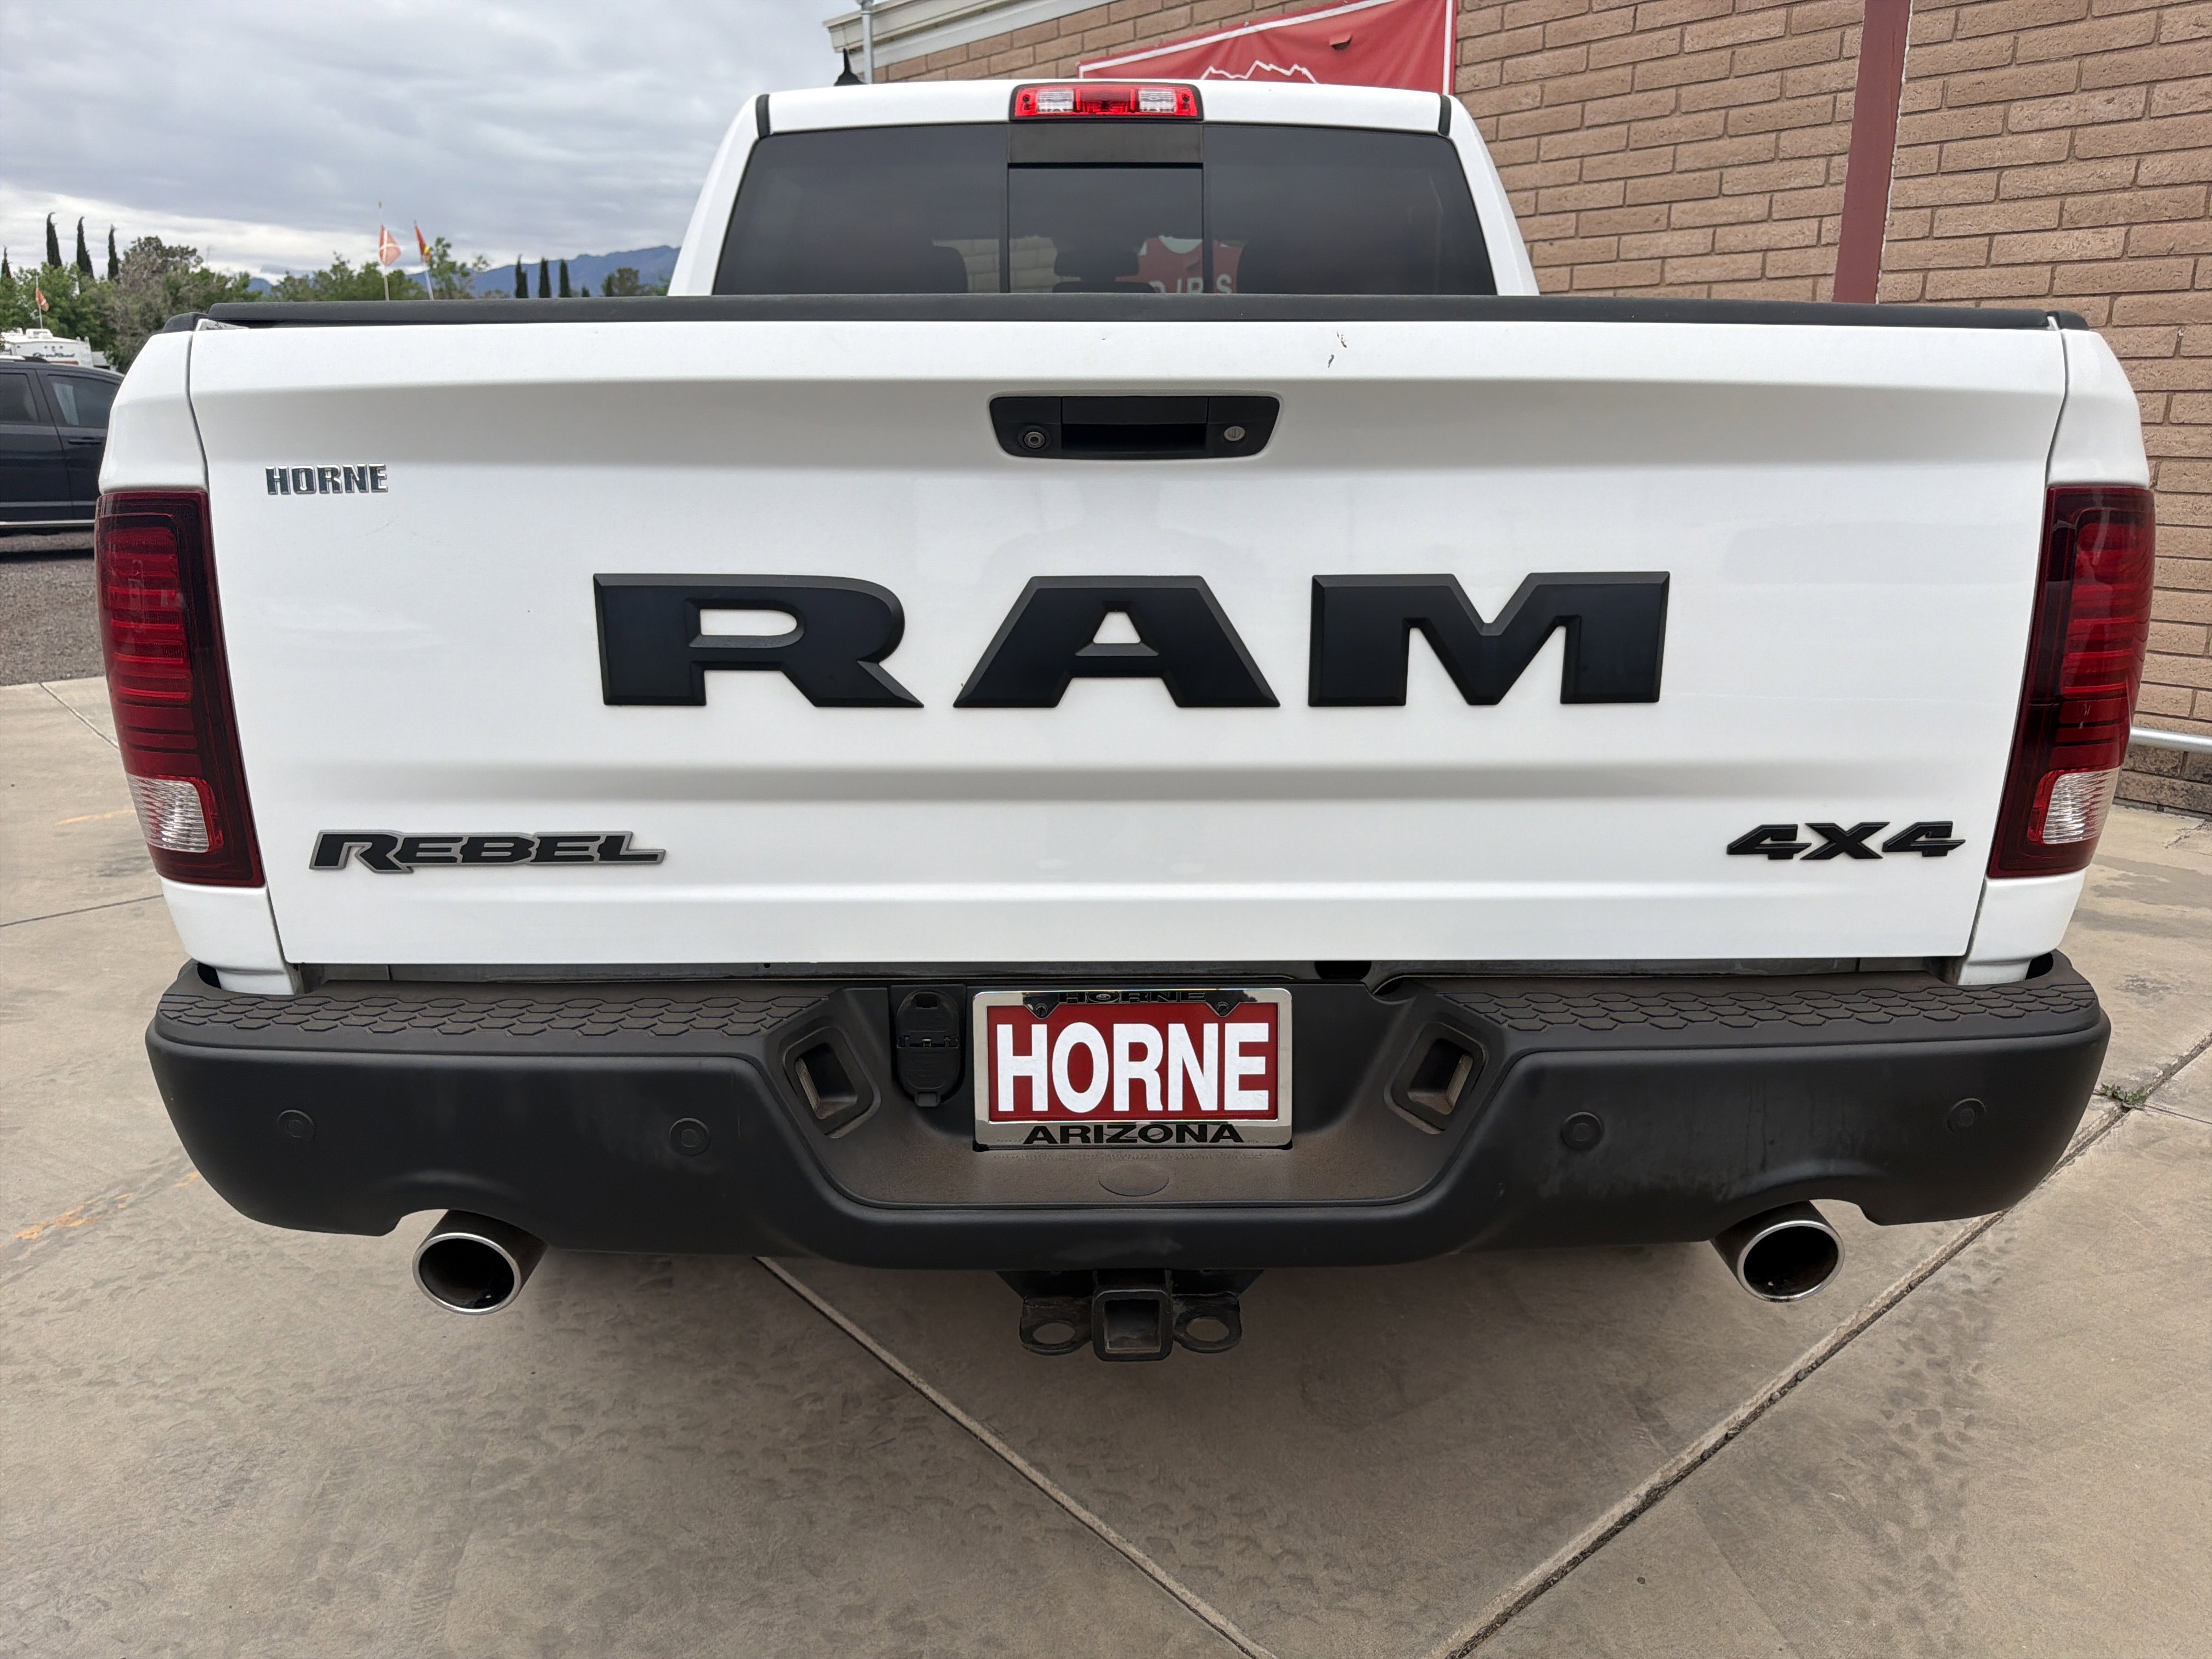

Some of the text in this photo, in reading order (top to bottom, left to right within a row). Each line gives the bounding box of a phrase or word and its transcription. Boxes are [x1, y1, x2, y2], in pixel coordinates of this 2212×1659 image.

[266, 464, 388, 495] HORNE
[594, 572, 1670, 708] RAM
[309, 829, 666, 873] REBEL
[1059, 990, 1206, 1003] HORNE
[996, 1022, 1269, 1113] HORNE
[1023, 1123, 1244, 1144] ARIZONA
